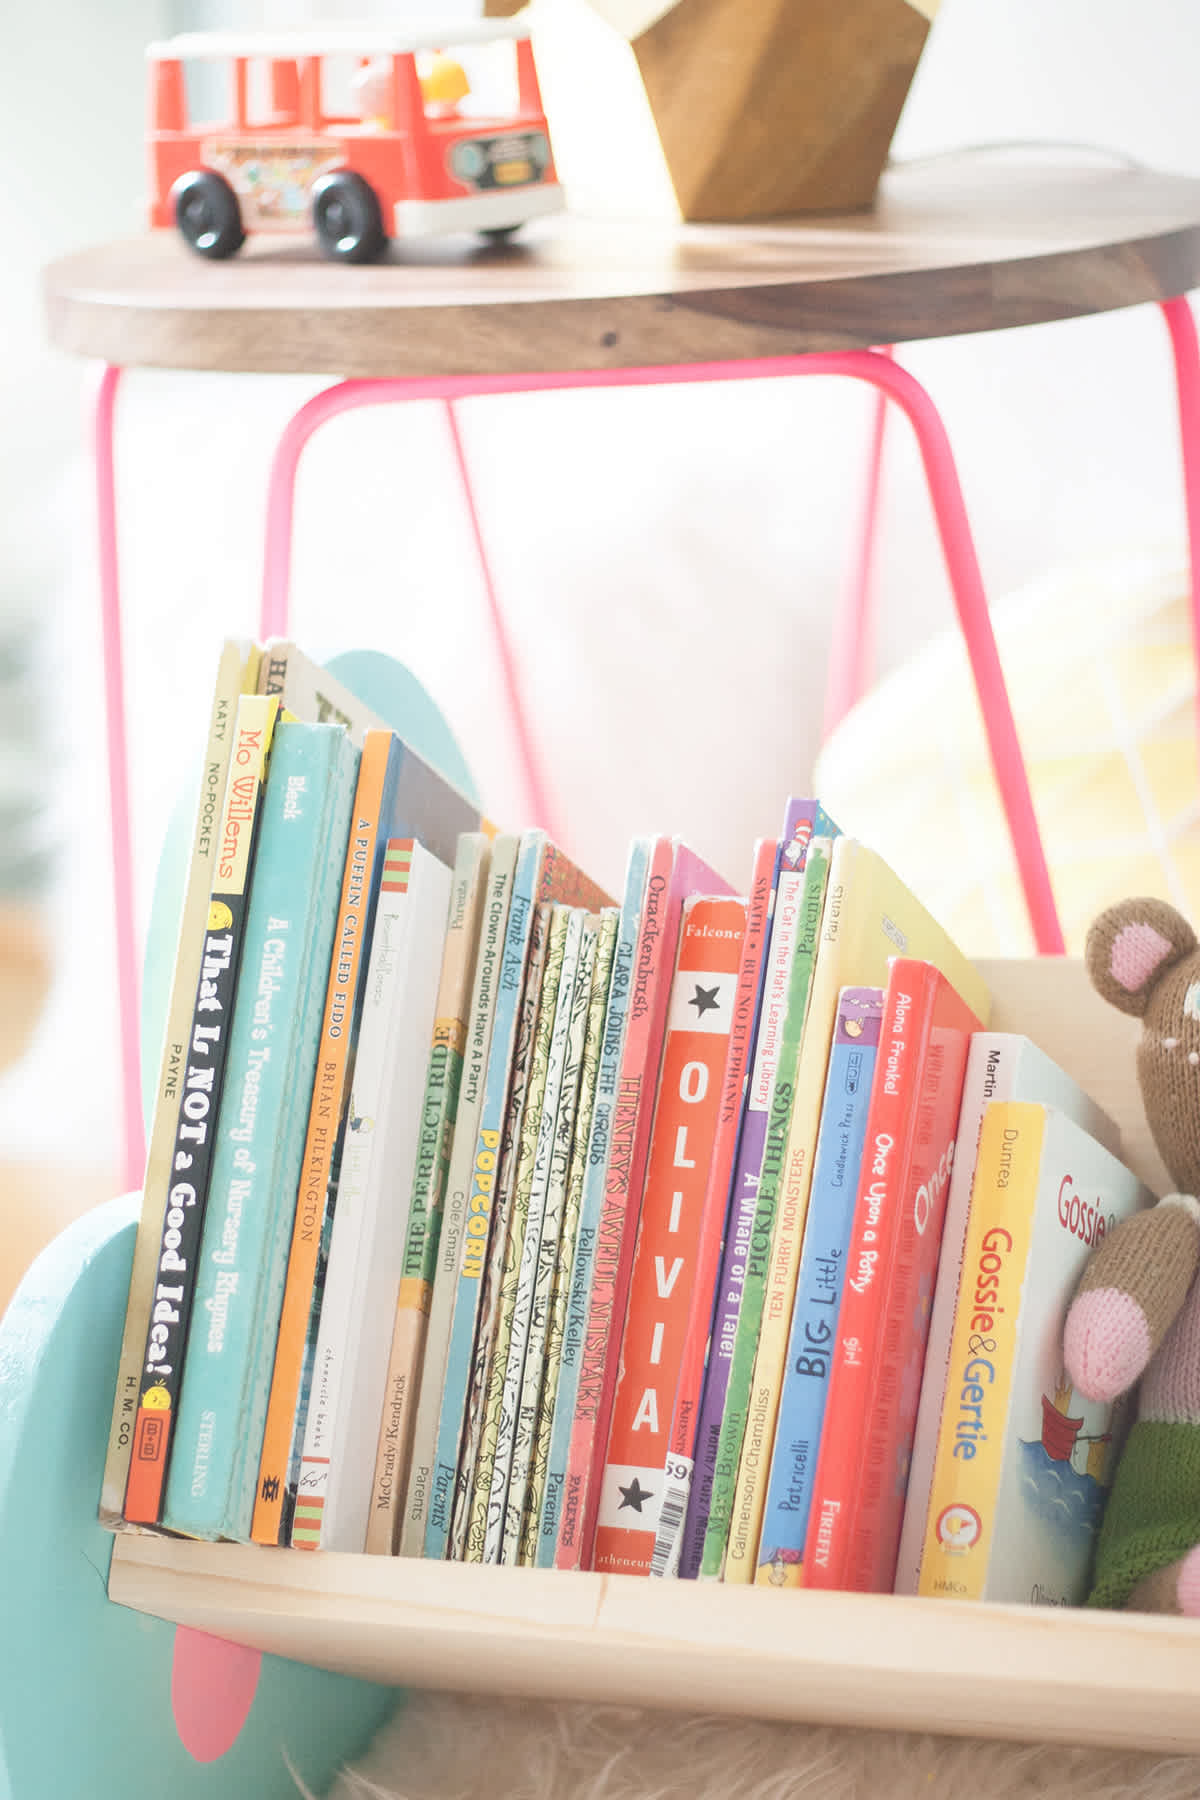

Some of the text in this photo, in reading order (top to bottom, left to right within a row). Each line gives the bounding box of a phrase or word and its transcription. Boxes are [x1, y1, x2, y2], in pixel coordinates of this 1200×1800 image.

[197, 699, 229, 856] KATY NO-POCKET
[218, 728, 261, 879] Mo Willems
[780, 905, 796, 927] Cat
[782, 878, 800, 903] The
[824, 885, 843, 941] Parents
[328, 818, 370, 1039] A PUFFIN CALLED FIDO
[501, 894, 530, 991] Frank Asch
[686, 923, 744, 940] Falcone
[776, 945, 792, 966] the
[462, 873, 507, 1103] The Clown-Arounds Have A Party
[720, 876, 767, 1123] SMATH BUT NO ELEPHANTS
[771, 968, 788, 999] Hat's
[588, 941, 633, 1166] CLARA JOINS THE CIRCUS
[760, 1002, 783, 1056] Learning
[883, 991, 911, 1095] Alona Frankel
[164, 1043, 181, 1099] PAYNE
[755, 1060, 775, 1104] Library
[982, 1049, 1001, 1099] Martin
[206, 916, 288, 1354] A Children's Treasury of Nursery Rhymes
[299, 1061, 336, 1242] BRIAN PILKINGTON
[405, 1024, 450, 1274] THE PERFECT RIDE
[839, 1101, 854, 1128] Press
[145, 932, 232, 1376] That Is NOT a Good Idea!
[742, 1171, 759, 1188] A
[747, 1080, 791, 1278] PICKLE THINGS
[831, 1132, 848, 1187] Candlewick
[872, 1132, 893, 1176] Once
[996, 1126, 1019, 1190] Dunrea
[443, 1190, 465, 1273] Cole/Smath
[460, 1127, 500, 1278] POPCORN
[733, 1197, 755, 1257] Whale
[768, 1148, 805, 1321] TEN FURRY MONSTERS
[860, 1179, 886, 1225] Upon
[863, 1230, 876, 1242] a
[574, 1072, 641, 1422] HENRY'S AWFUL MISTAKE
[631, 1061, 709, 1432] OLIVIA
[848, 1247, 877, 1294] Potty
[562, 1226, 595, 1367] Pellowski/Kelley
[726, 1291, 739, 1303] a
[794, 1245, 842, 1378] BIG Little
[844, 1336, 861, 1365] girl
[117, 1375, 136, 1450] H. M. CO.
[376, 1373, 405, 1509] McCrady/Kendrick
[190, 1409, 216, 1497] STERLING
[707, 1411, 740, 1533] Marc Brown
[731, 1386, 769, 1560] Calmenson/Chambliss
[777, 1438, 809, 1512] Patricelli
[410, 1466, 428, 1521] Parents
[541, 1471, 564, 1536] Parents
[561, 1473, 581, 1547] PARENTS
[813, 1499, 840, 1568] FIREFLY
